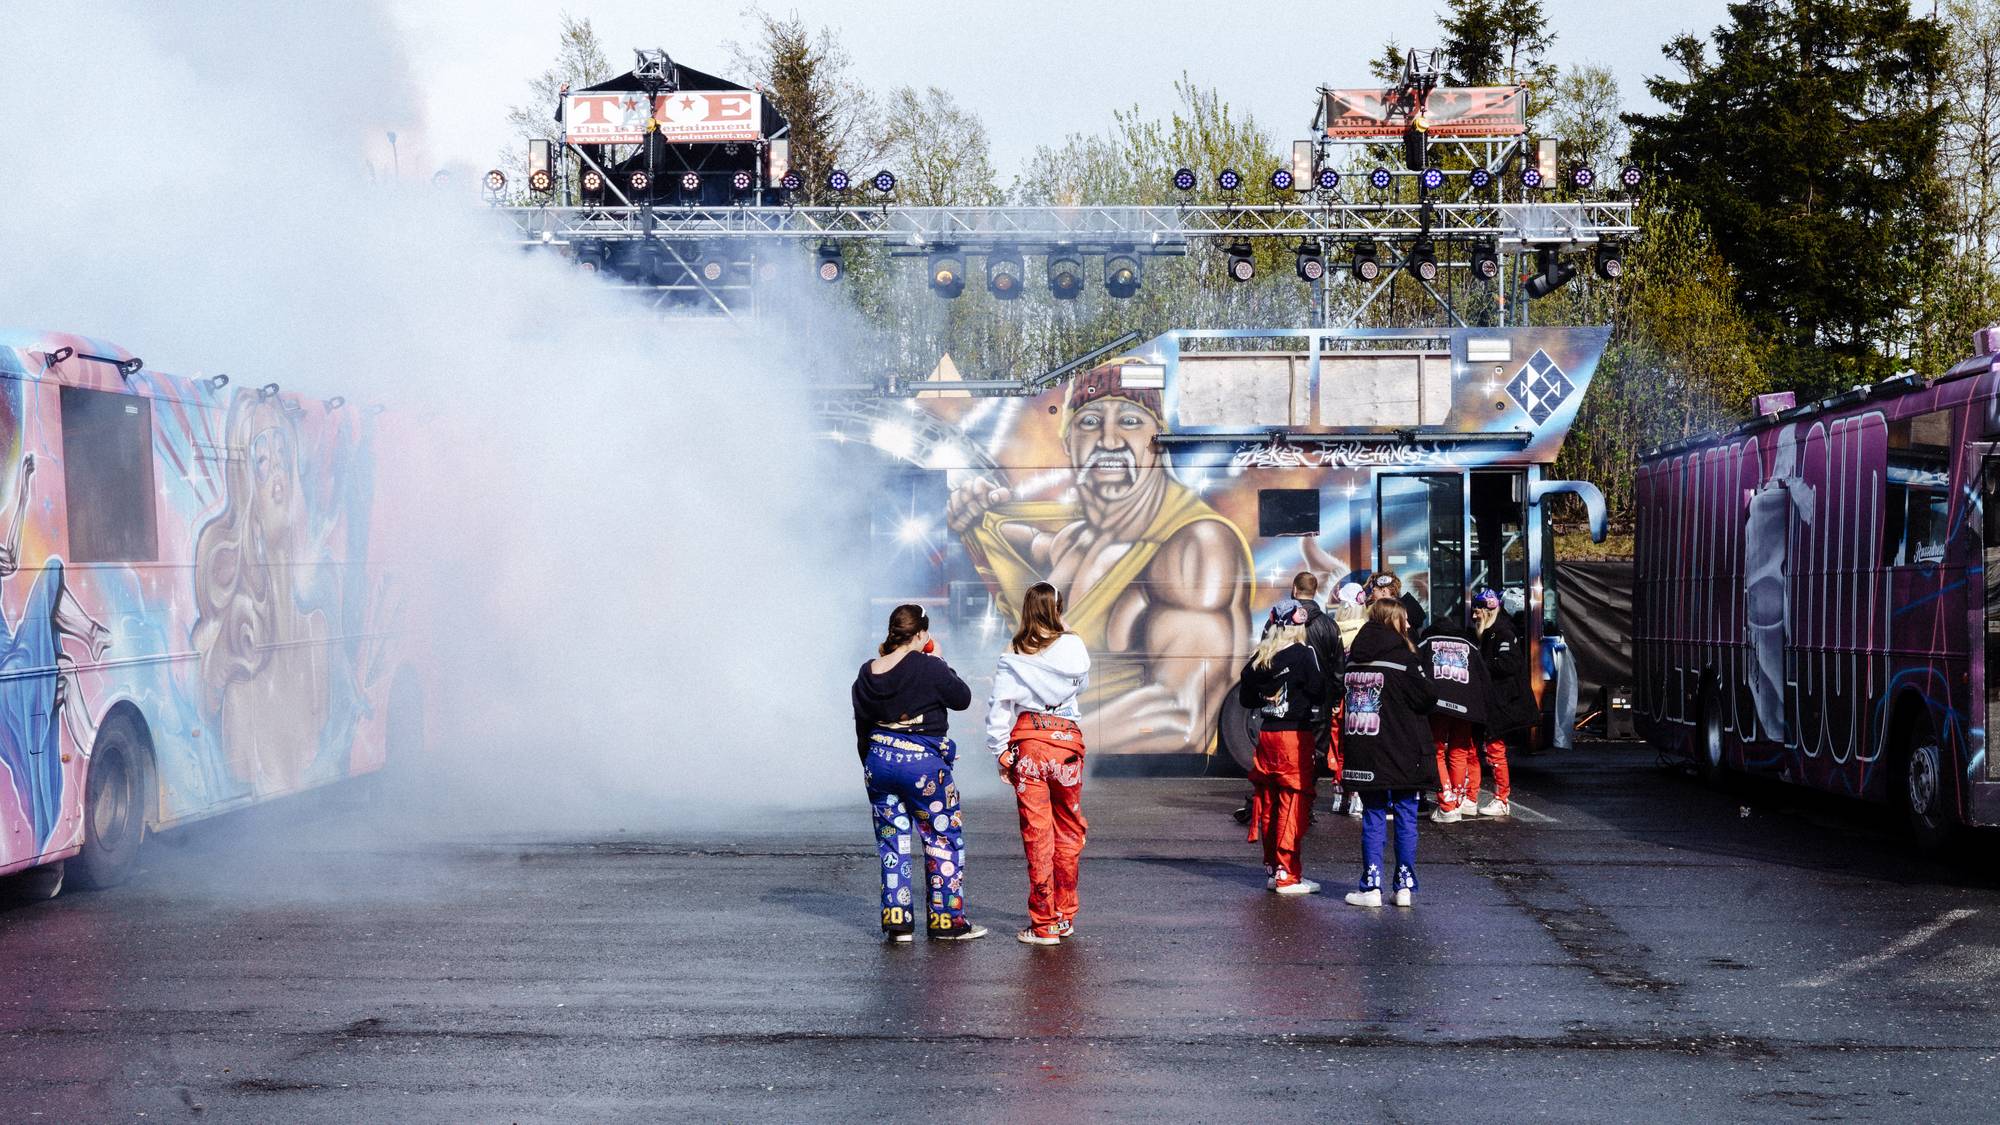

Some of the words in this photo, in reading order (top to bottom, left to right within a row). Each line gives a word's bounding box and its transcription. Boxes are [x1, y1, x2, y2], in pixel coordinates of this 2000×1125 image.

[574, 125, 610, 134] This
[1335, 118, 1371, 126] This
[1434, 665, 1469, 684] LOUD
[883, 906, 903, 925] 20
[930, 912, 952, 929] 26
